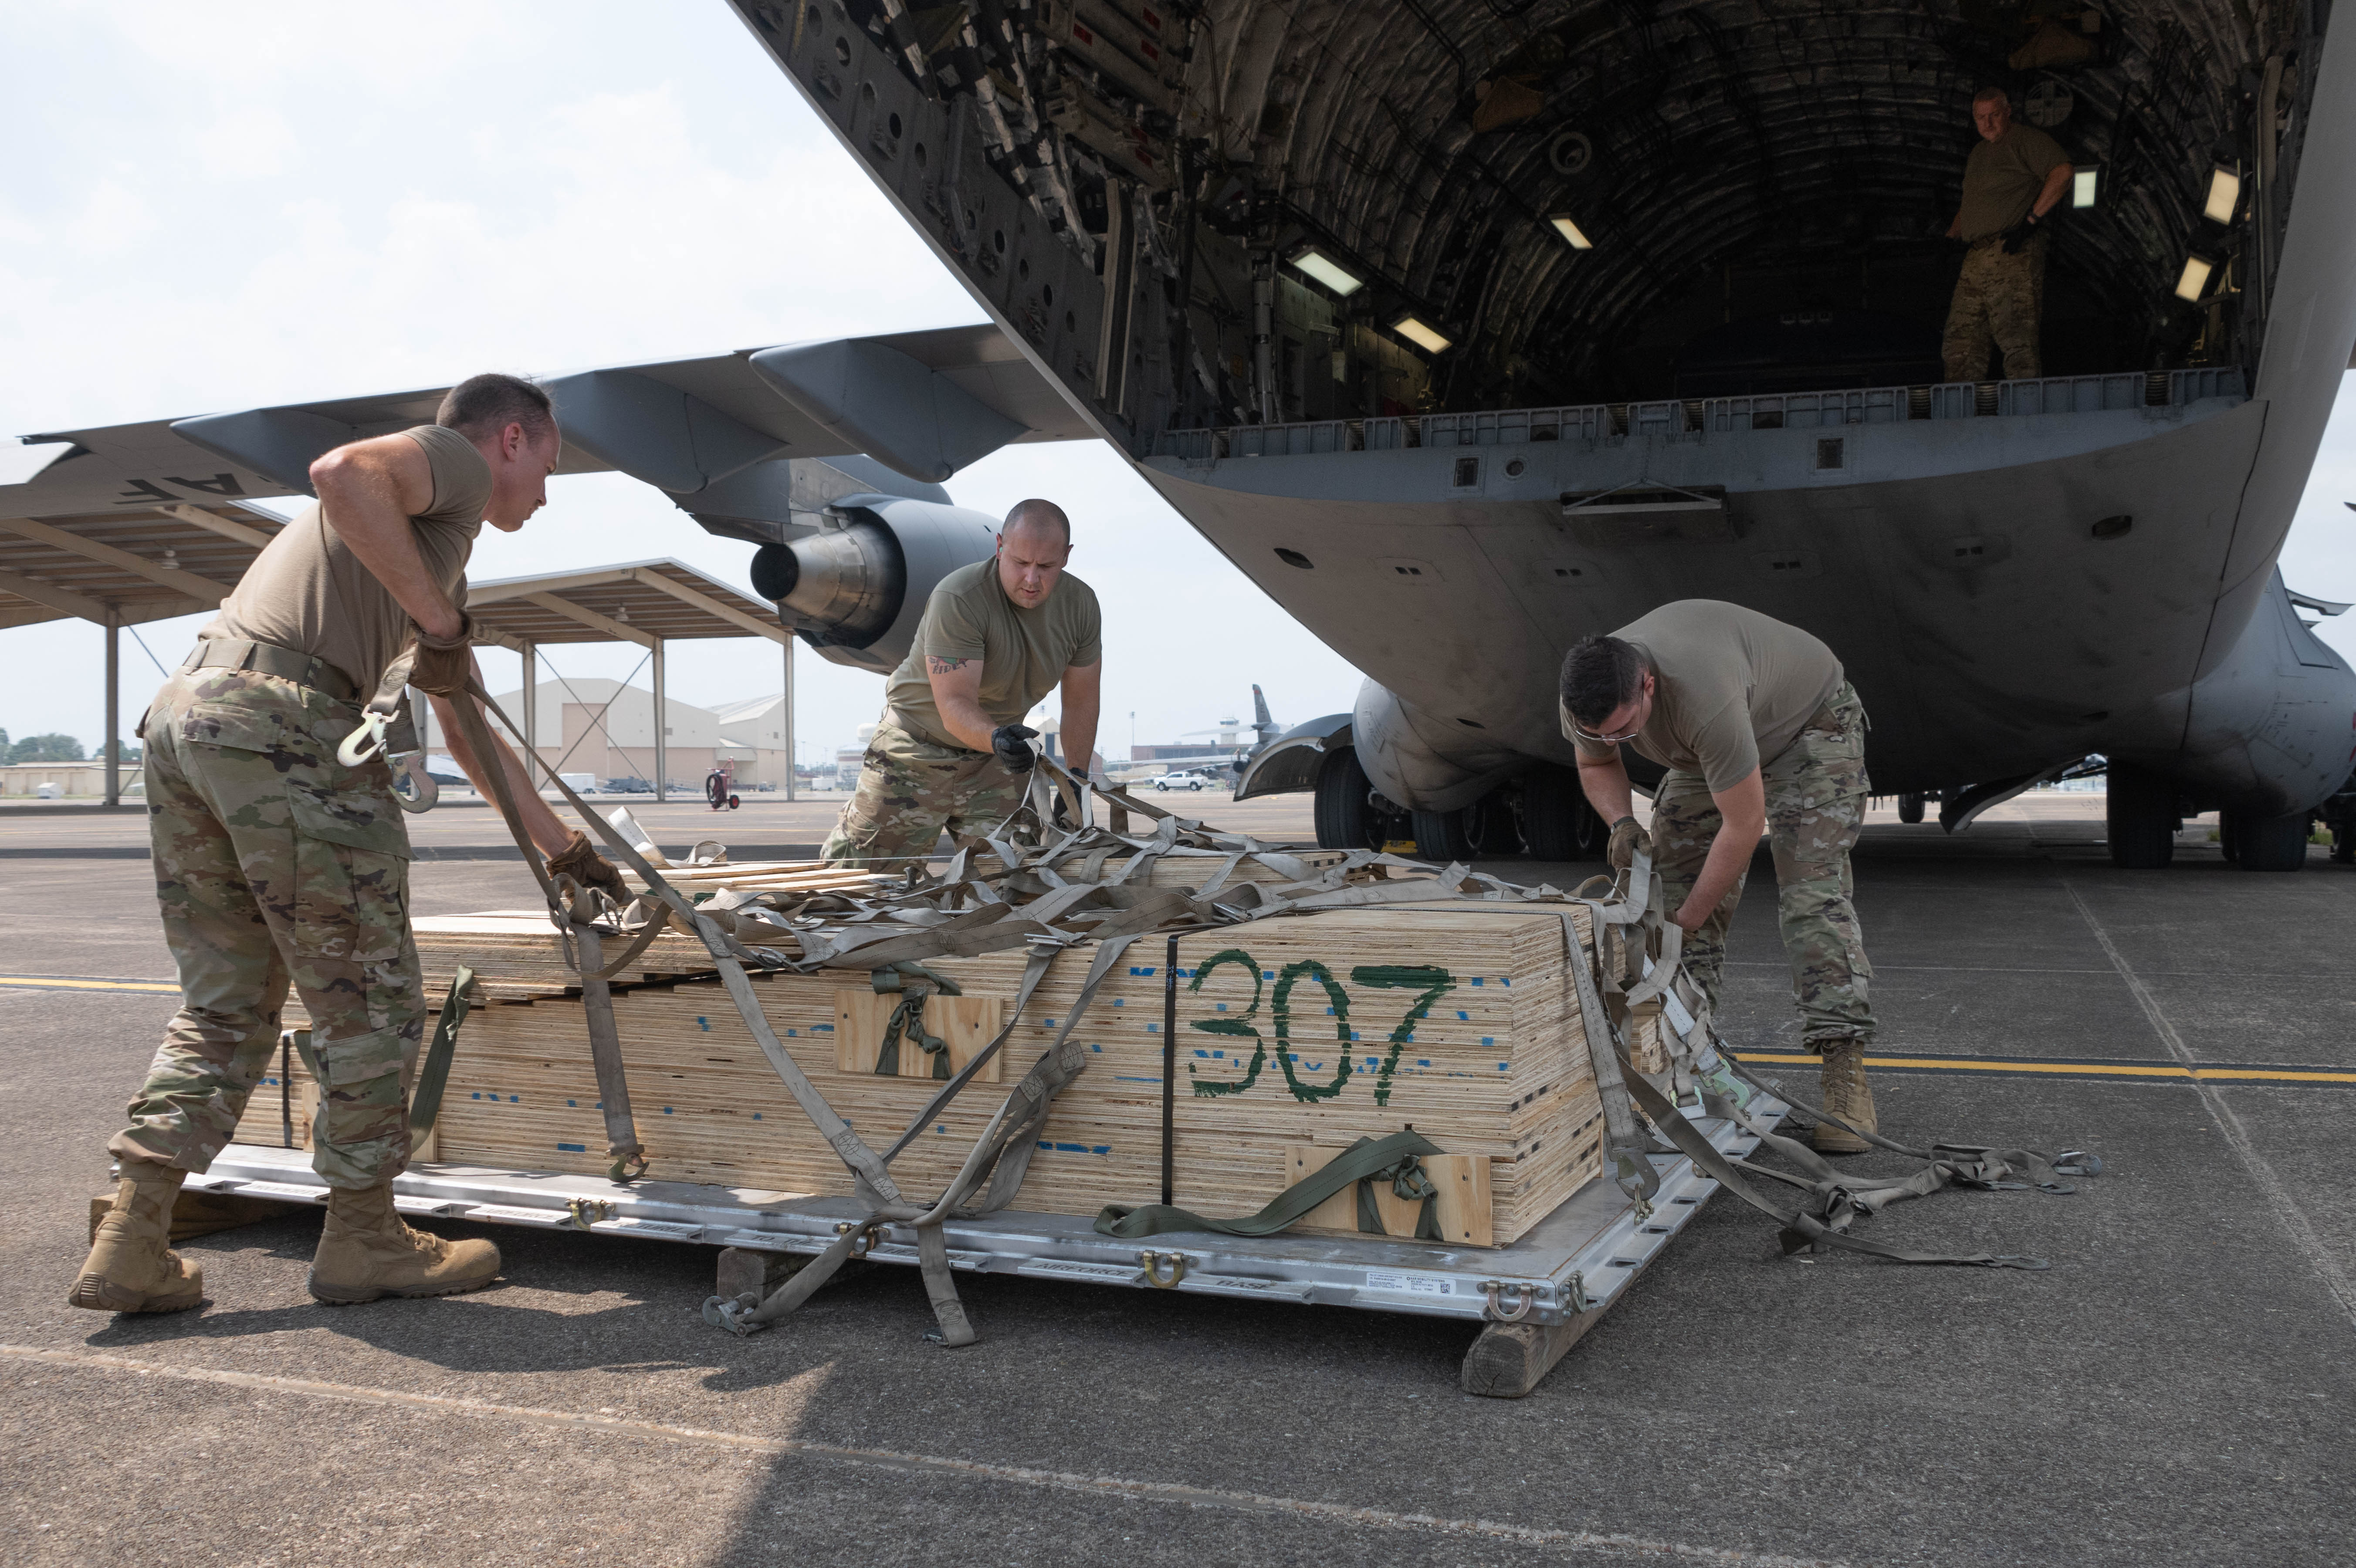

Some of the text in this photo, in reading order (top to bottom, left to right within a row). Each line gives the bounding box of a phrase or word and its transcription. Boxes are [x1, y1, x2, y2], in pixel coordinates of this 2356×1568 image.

[1187, 948, 1457, 1107] 307
[1034, 1263, 1135, 1277] AIRFORCE
[1216, 1280, 1273, 1290] BASE
